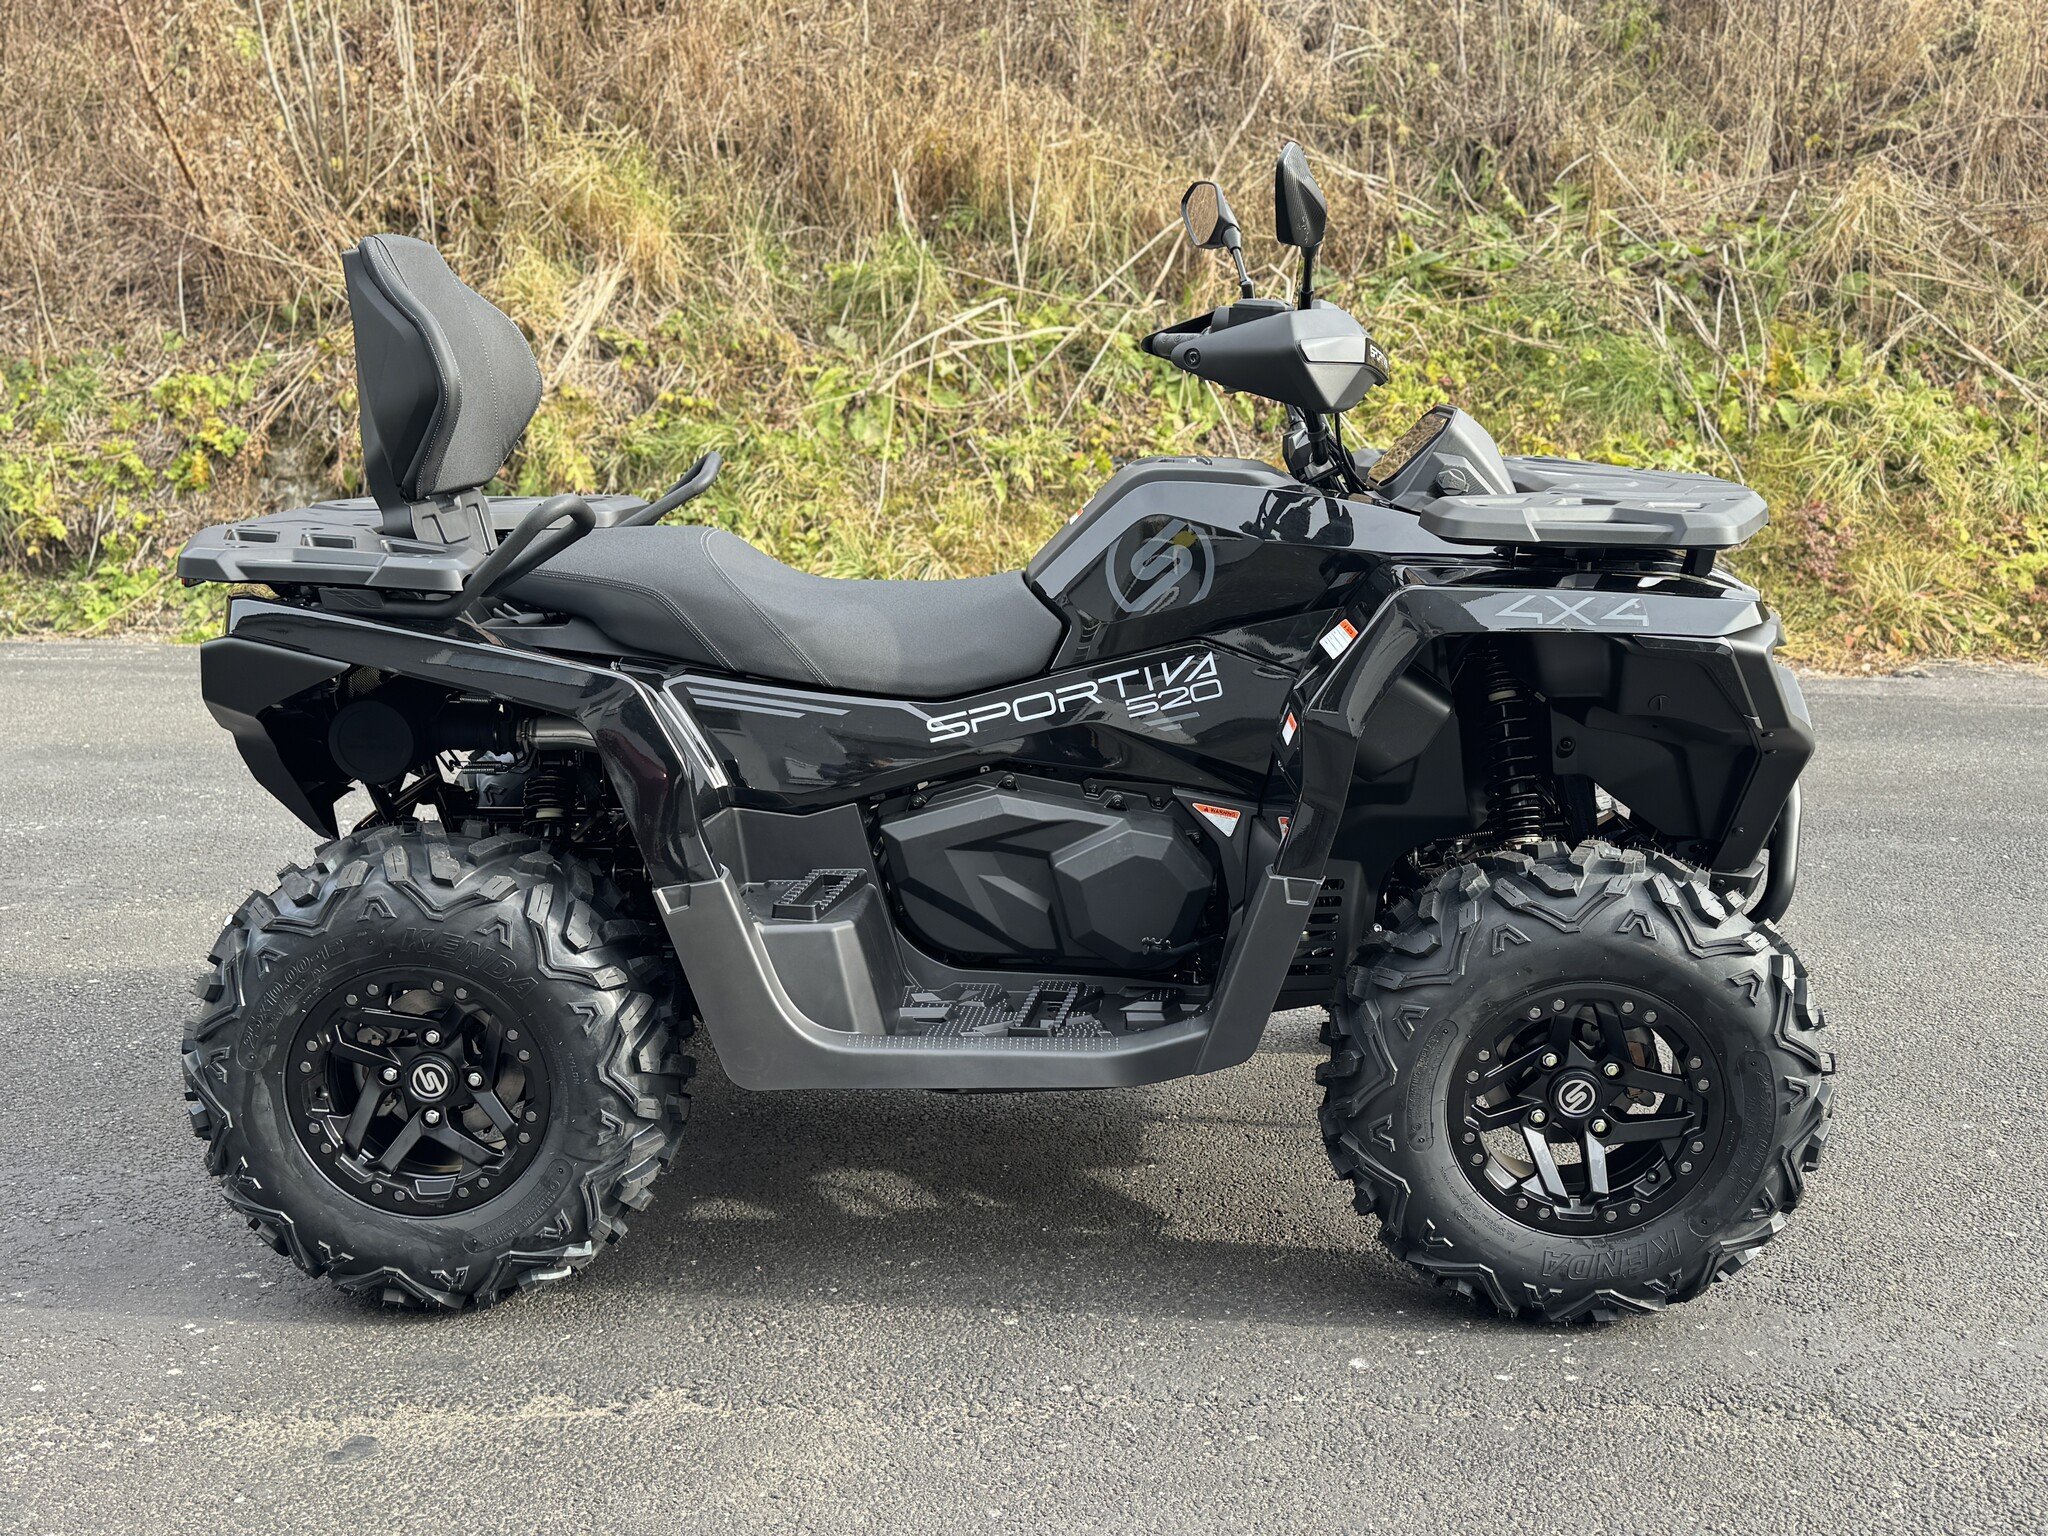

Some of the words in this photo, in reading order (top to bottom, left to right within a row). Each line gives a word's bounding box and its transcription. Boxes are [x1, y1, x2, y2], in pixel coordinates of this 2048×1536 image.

[1495, 594, 1650, 627] 4X4
[926, 651, 1218, 743] SPORTIVA
[1125, 679, 1223, 719] 520
[401, 927, 539, 1000] KENDA
[1541, 1227, 1682, 1281] KENDA
